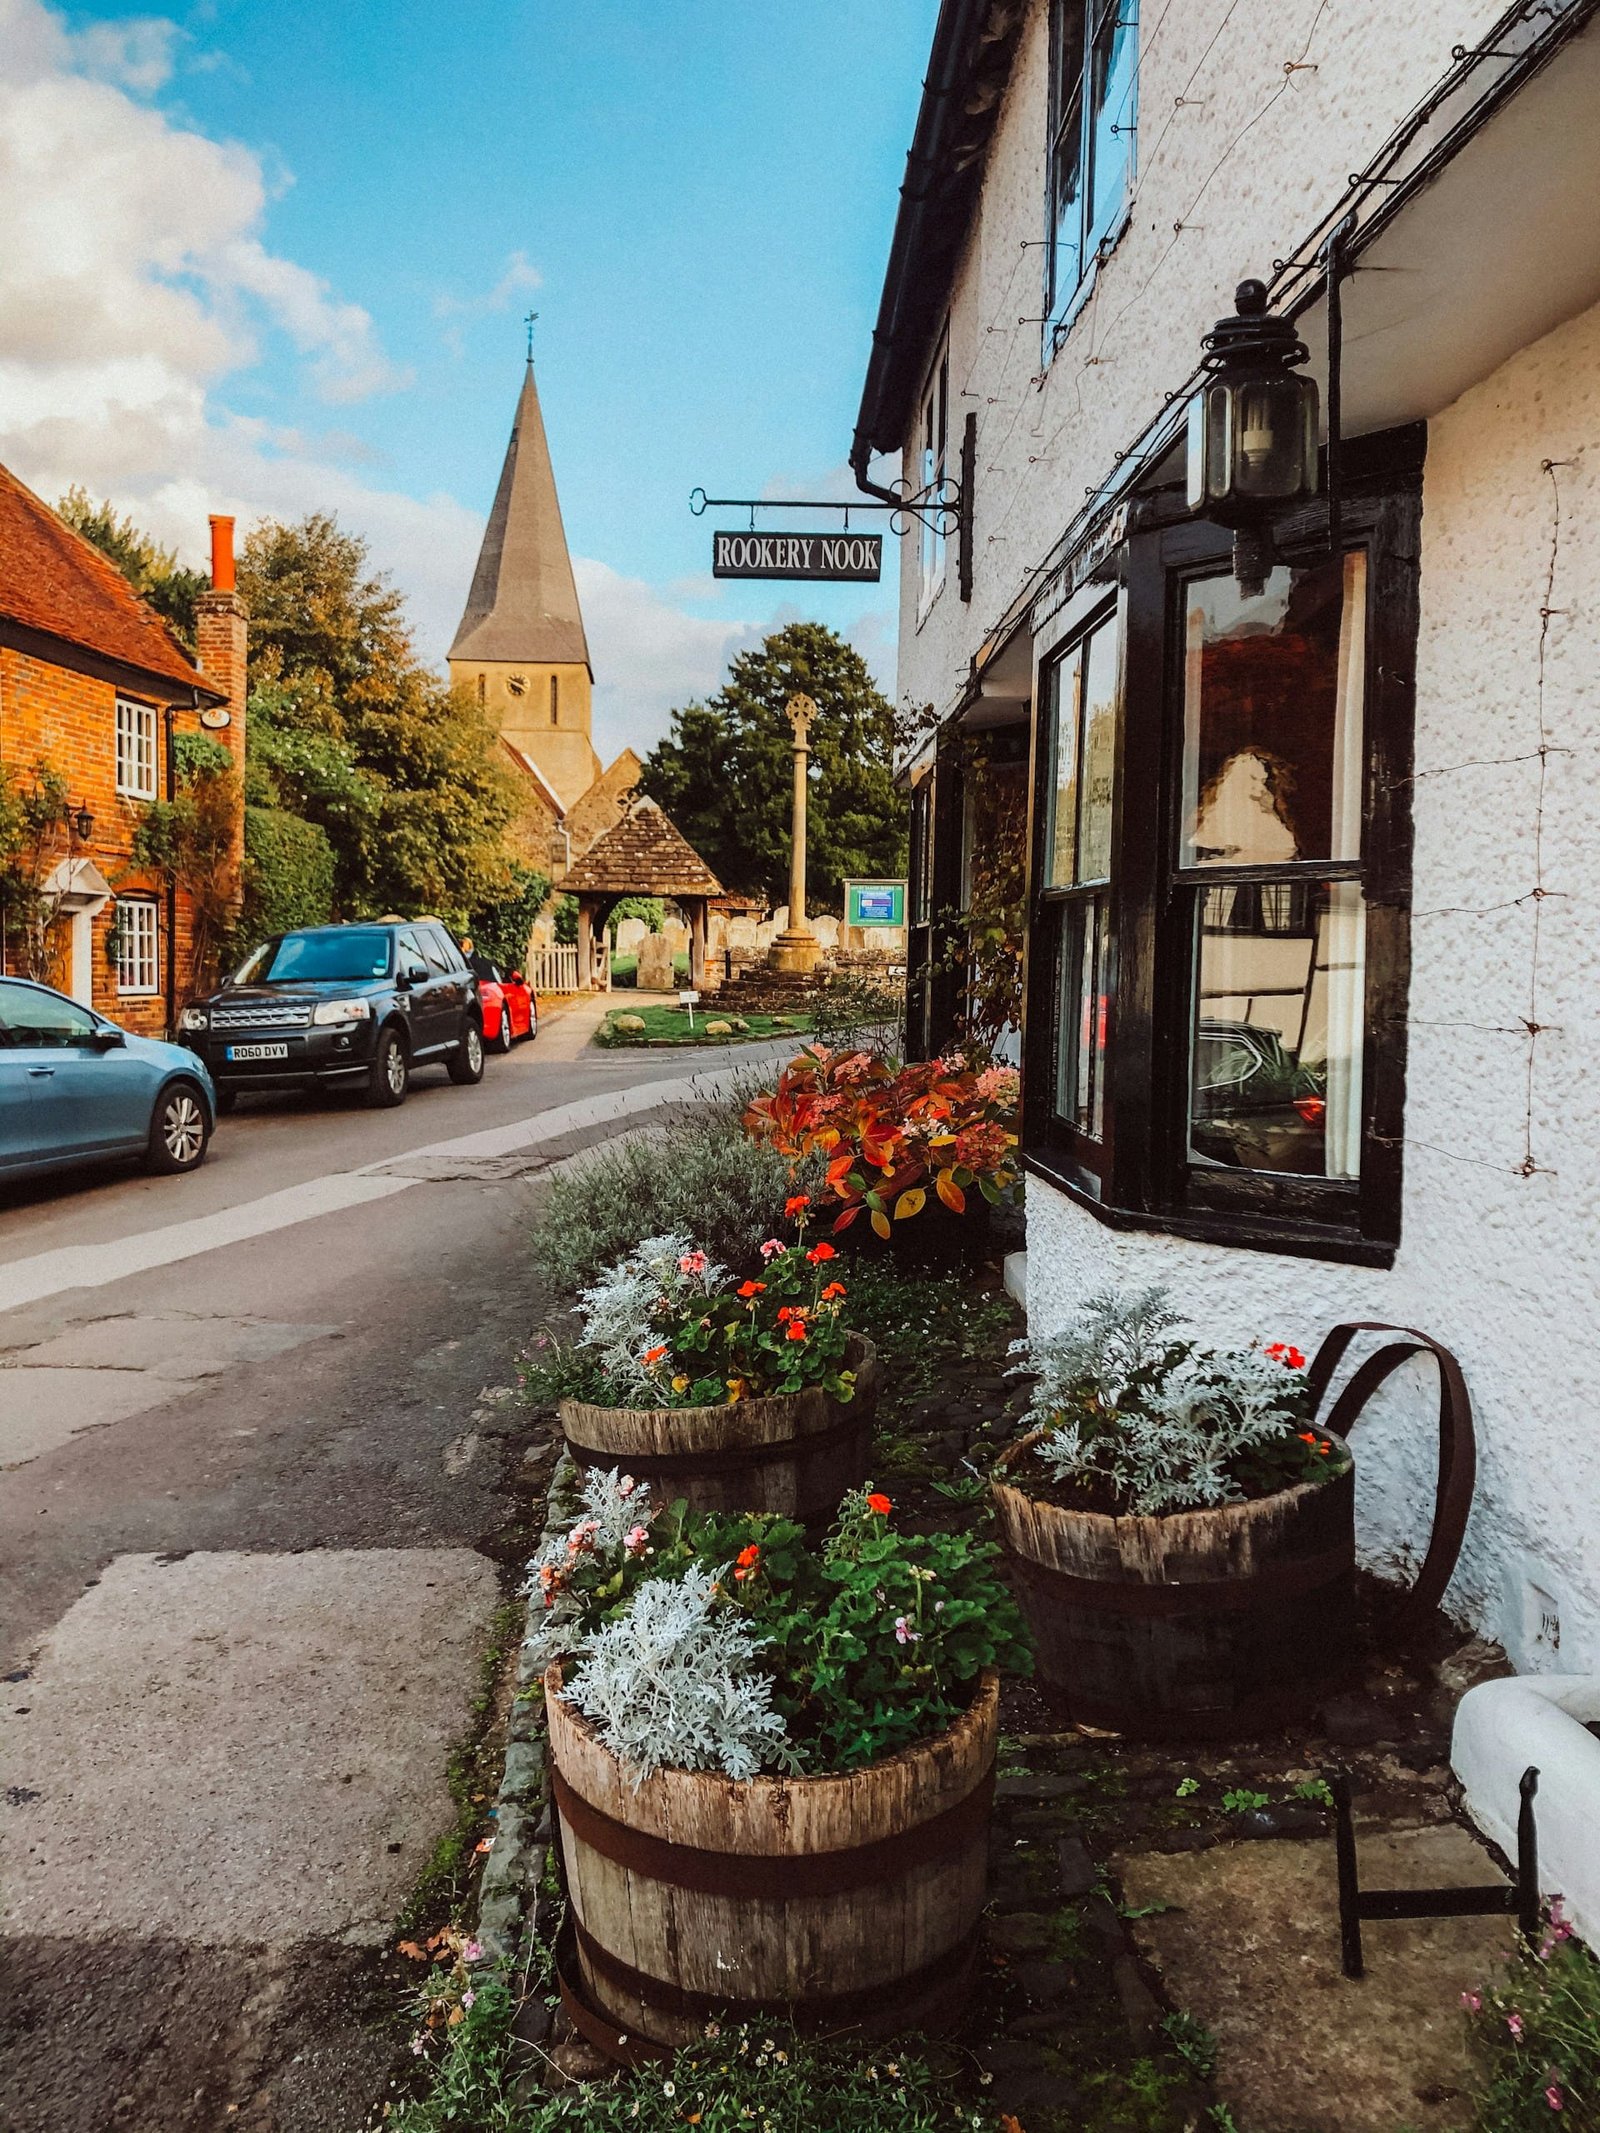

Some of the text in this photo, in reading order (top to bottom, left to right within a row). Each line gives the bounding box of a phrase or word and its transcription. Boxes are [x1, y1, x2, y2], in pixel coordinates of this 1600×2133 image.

[717, 537, 879, 570] ROOKERY NOOK
[234, 1046, 286, 1058] RO60 DVV
